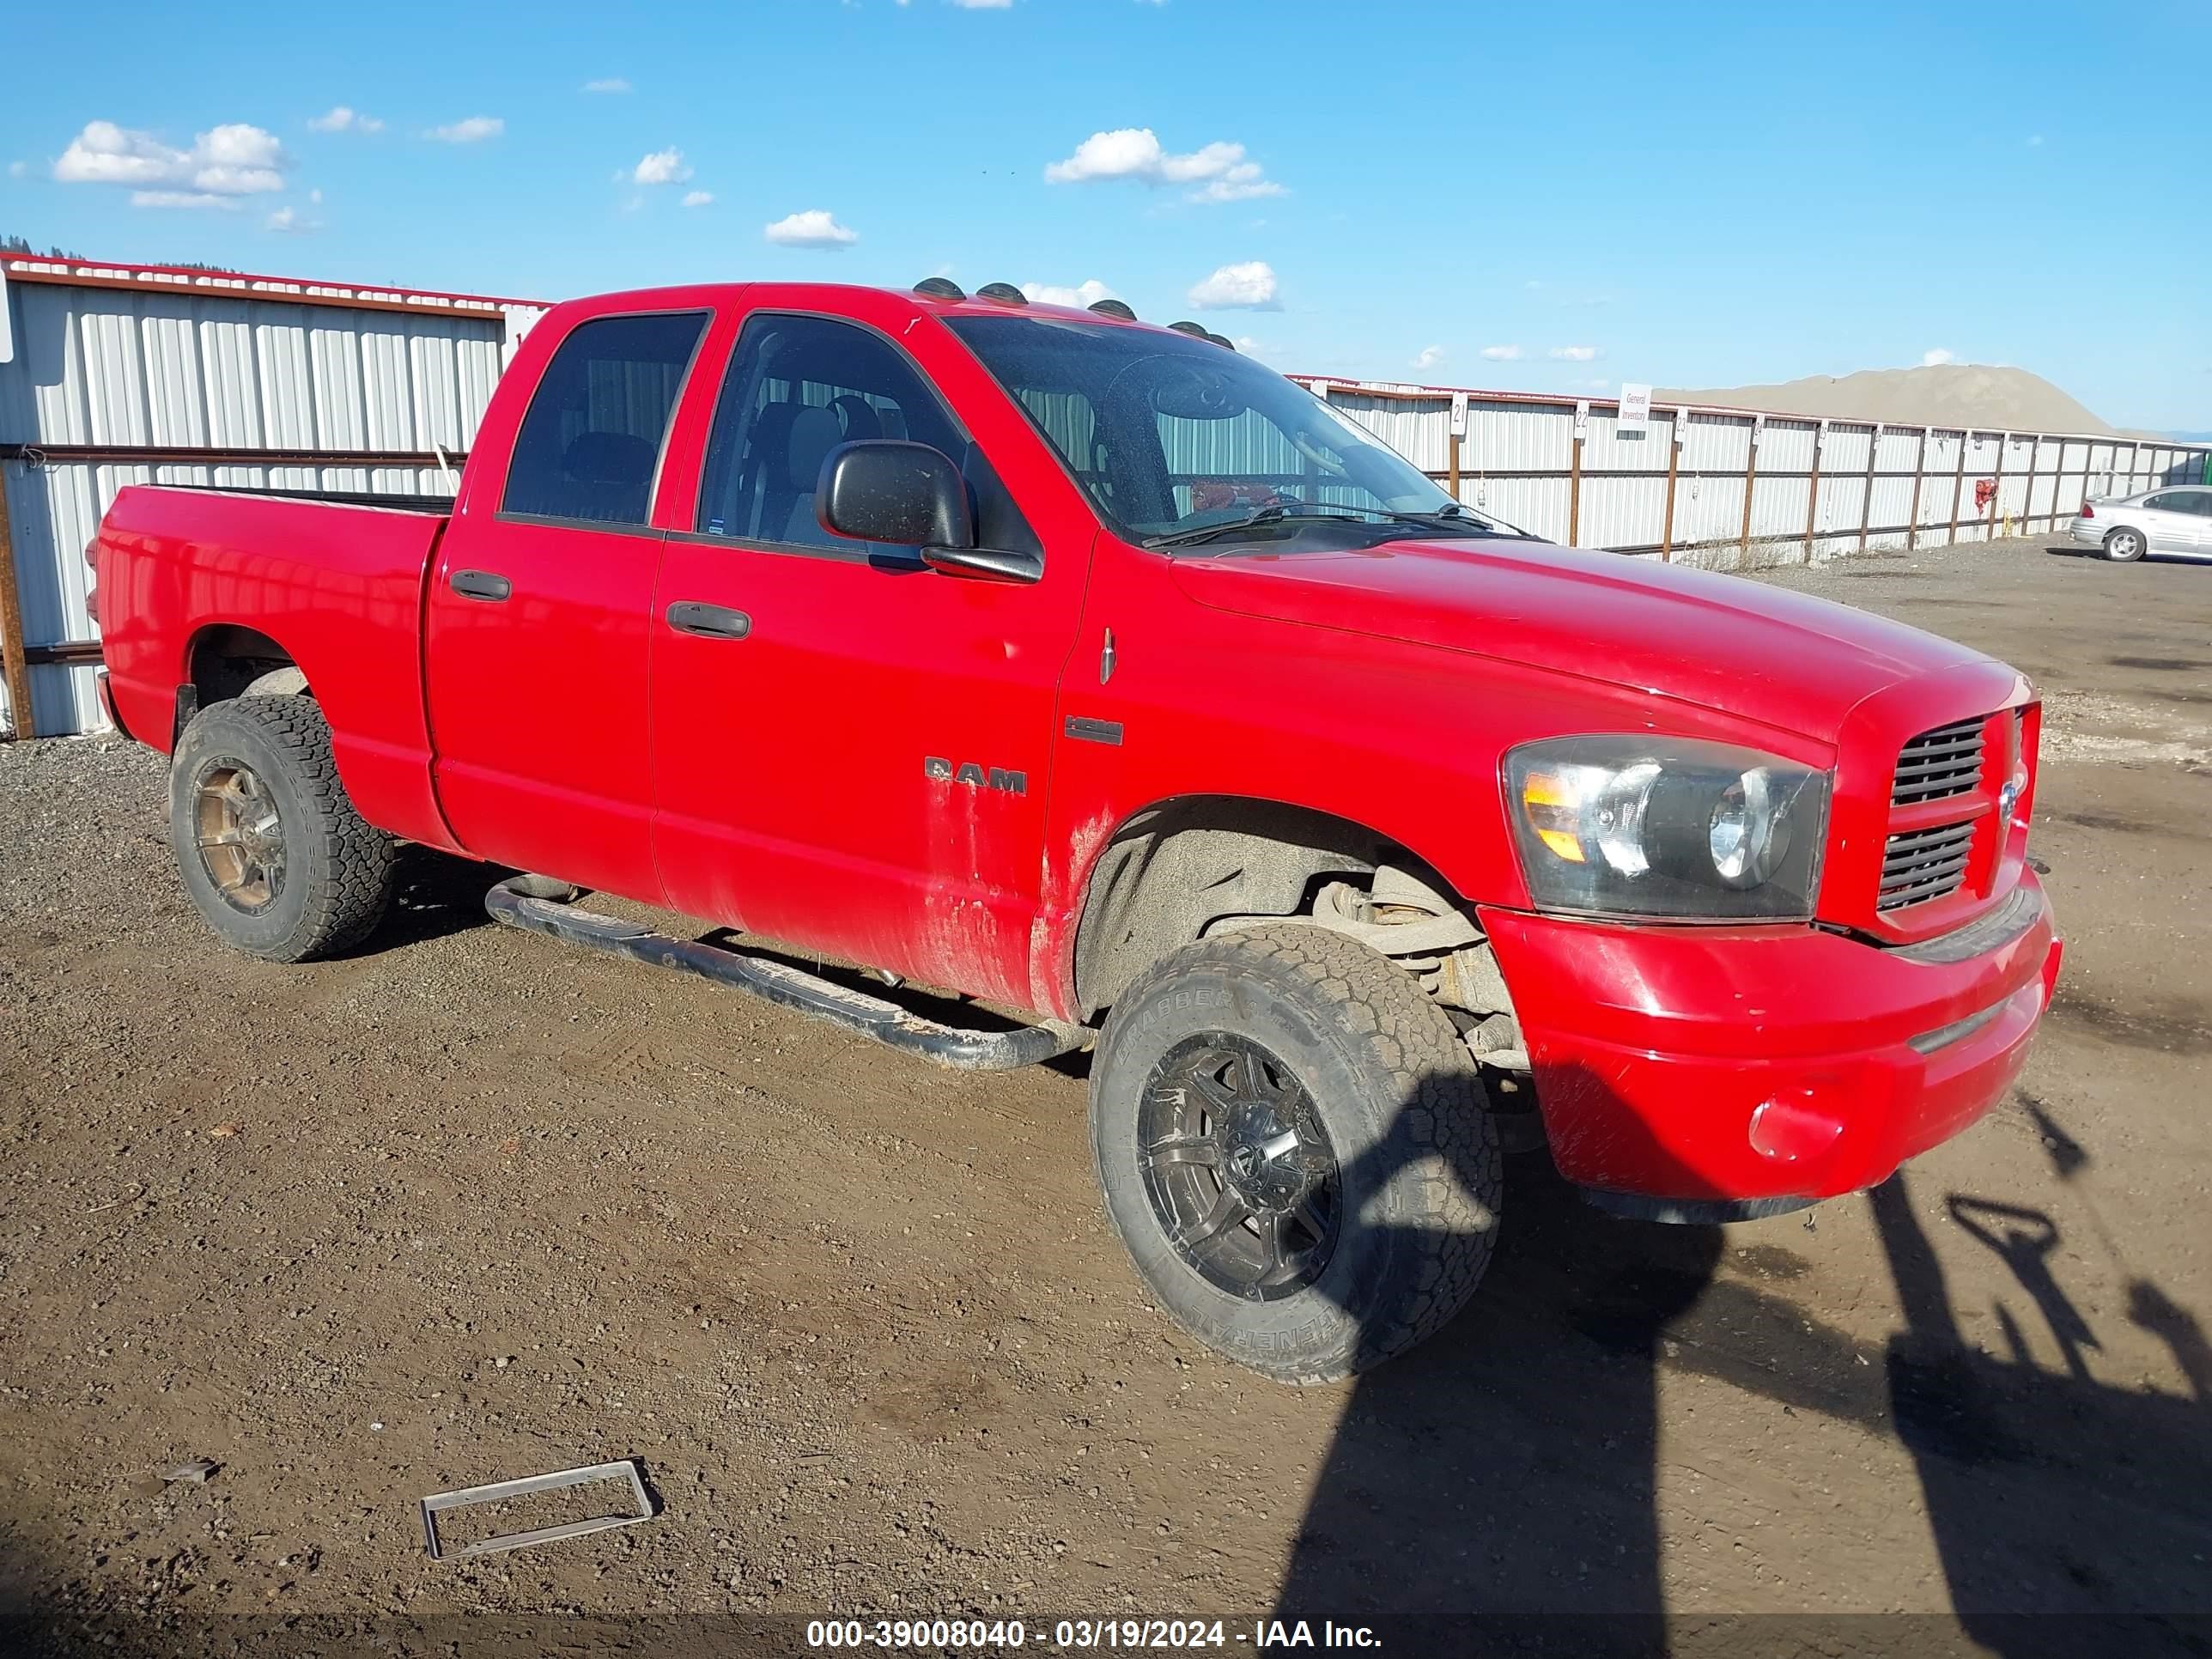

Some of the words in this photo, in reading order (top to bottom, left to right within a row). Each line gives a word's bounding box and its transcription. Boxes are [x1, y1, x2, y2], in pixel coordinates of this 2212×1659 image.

[1626, 392, 1646, 404] General
[1454, 404, 1465, 422] 21
[1577, 410, 1588, 428] 22
[1622, 410, 1646, 422] Inventory
[1677, 416, 1686, 432] 23
[925, 756, 1027, 795] RAM
[1115, 988, 1234, 1066] GRABBER
[1189, 1304, 1343, 1352] GENERAL
